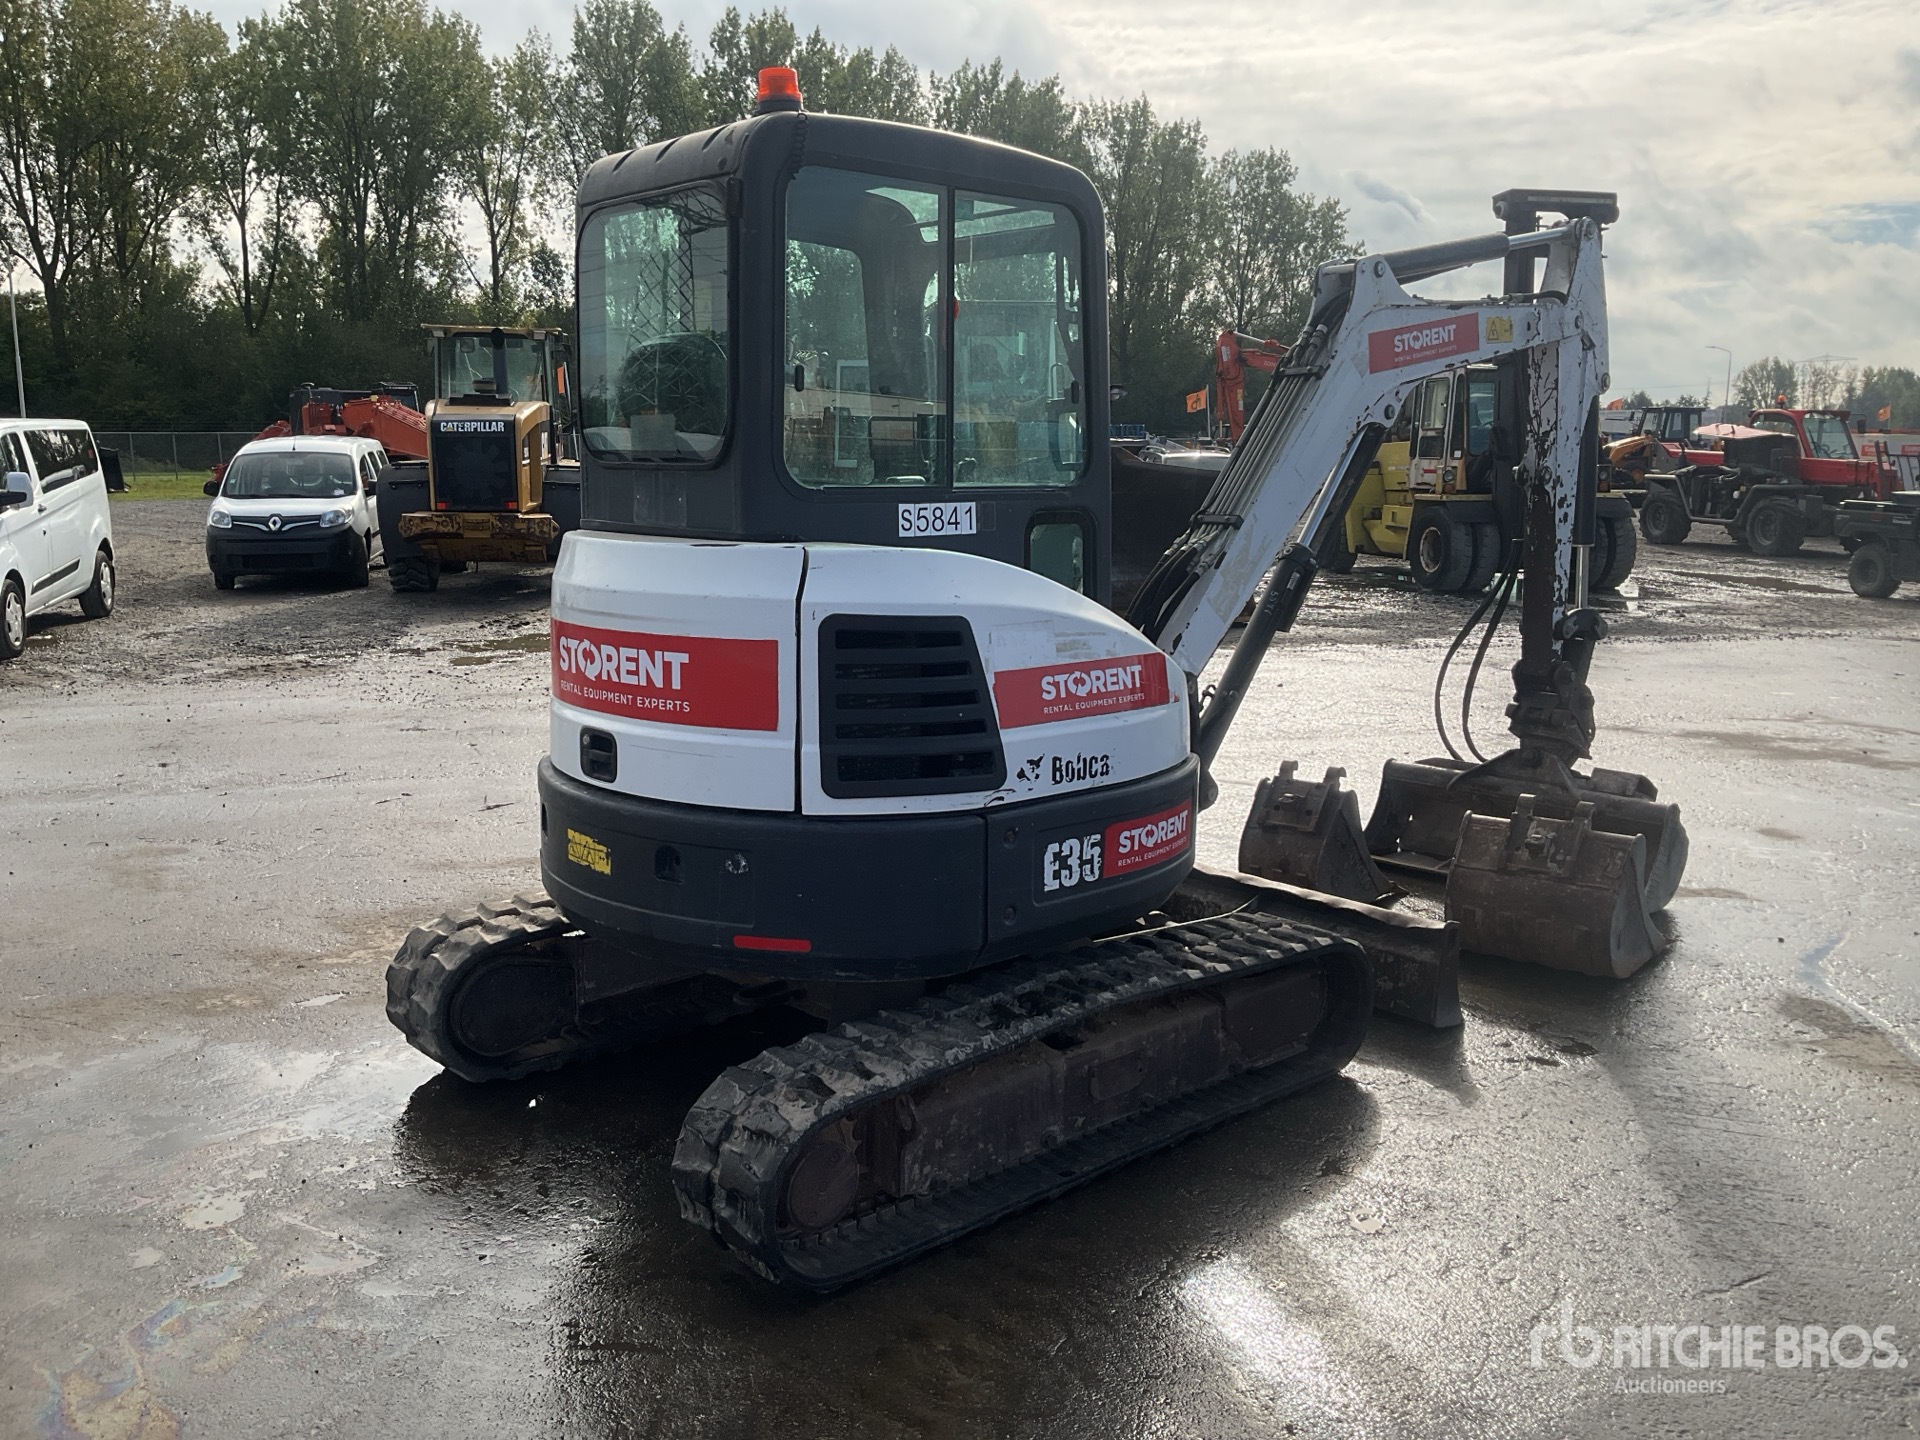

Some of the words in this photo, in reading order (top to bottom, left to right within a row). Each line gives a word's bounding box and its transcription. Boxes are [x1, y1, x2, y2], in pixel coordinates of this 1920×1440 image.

[1393, 324, 1457, 353] STORENT
[440, 421, 505, 432] CATERPILLAR
[900, 505, 973, 532] S5841
[559, 635, 690, 690] STORENT
[560, 679, 582, 696] RENTAL
[583, 686, 633, 706] EQUIPMENT
[636, 696, 691, 713] EXPERTS
[1041, 664, 1142, 701] STORENT
[1043, 701, 1074, 715] RENTAL
[1075, 697, 1118, 711] EQUIPMENT
[1118, 692, 1145, 704] EXPERTS
[1051, 752, 1113, 786] Bobca
[1118, 809, 1189, 854] STORENT
[1043, 833, 1102, 892] E35
[1117, 855, 1143, 867] RENTAL
[1143, 844, 1172, 860] EQUIPMENT
